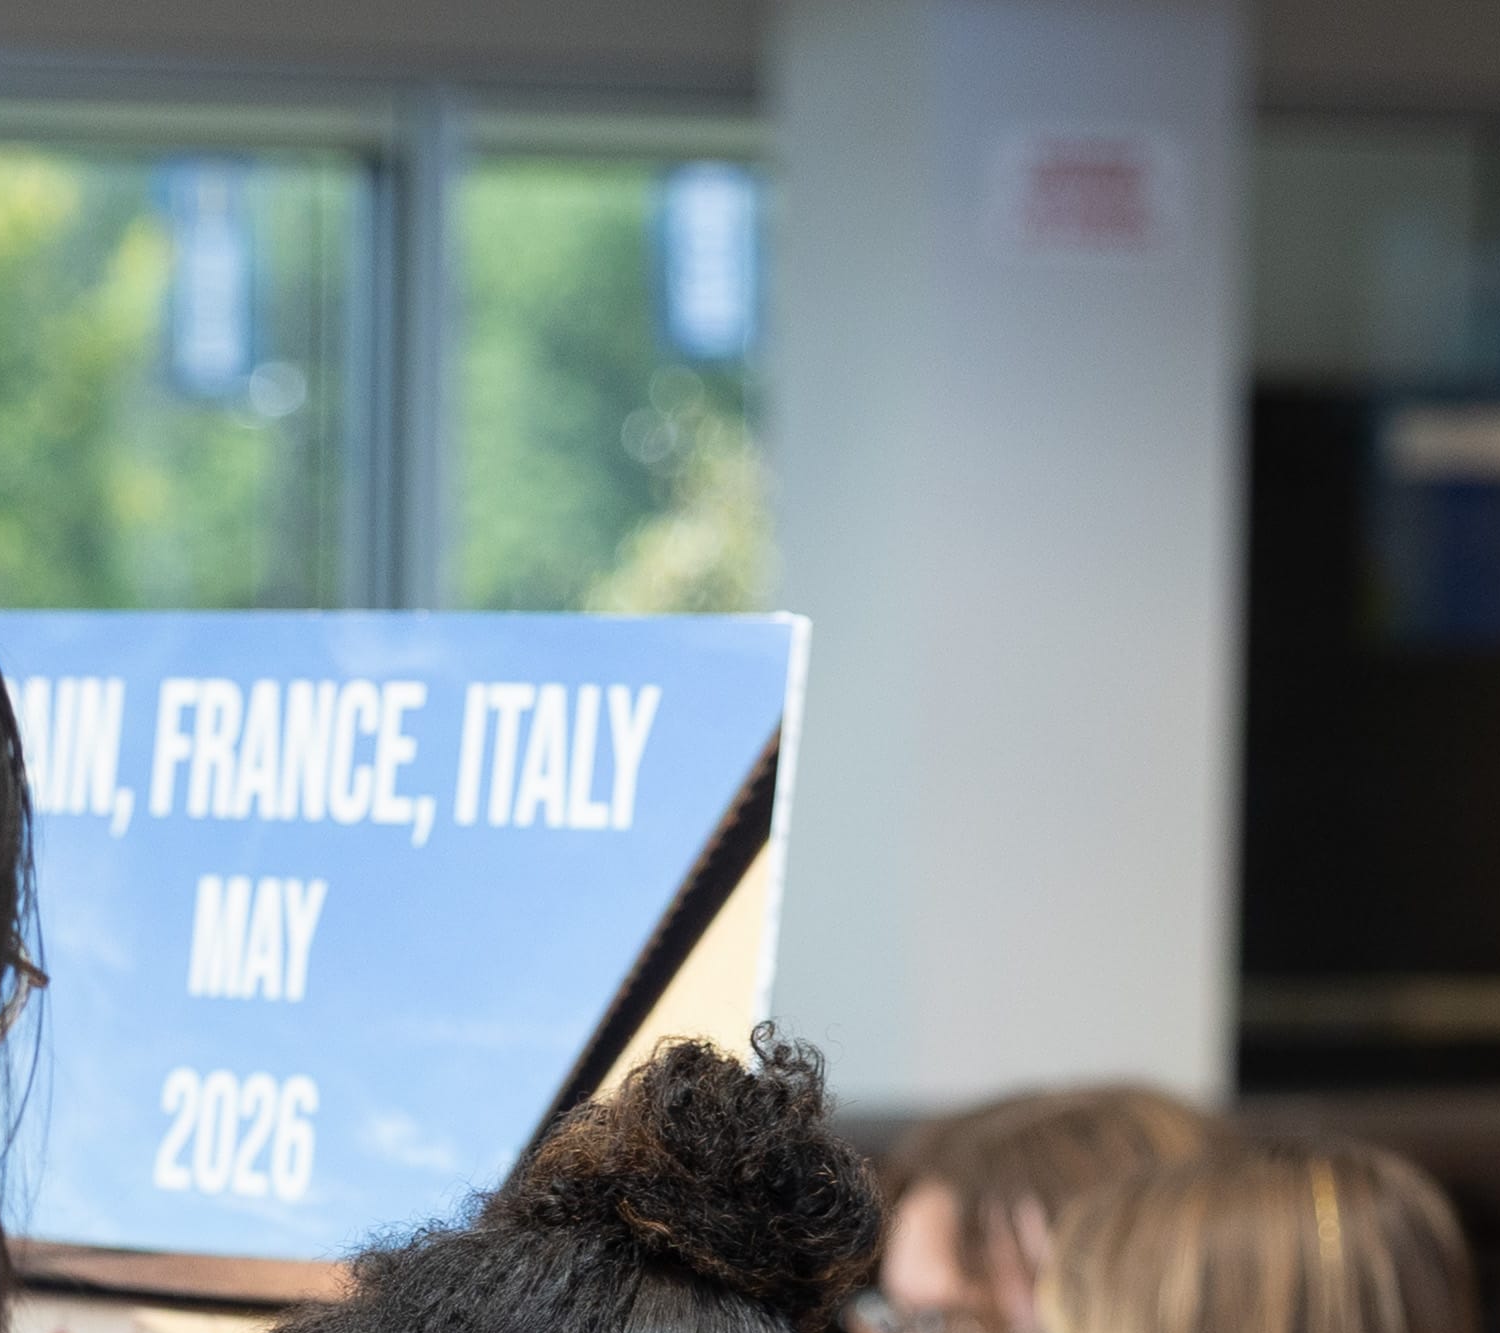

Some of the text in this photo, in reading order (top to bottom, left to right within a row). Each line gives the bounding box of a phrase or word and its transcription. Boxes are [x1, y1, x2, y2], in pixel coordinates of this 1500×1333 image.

[149, 677, 436, 846] FRANCE,
[455, 684, 662, 832] ITALY
[187, 875, 328, 1003] MAY
[152, 1065, 319, 1203] 2026
